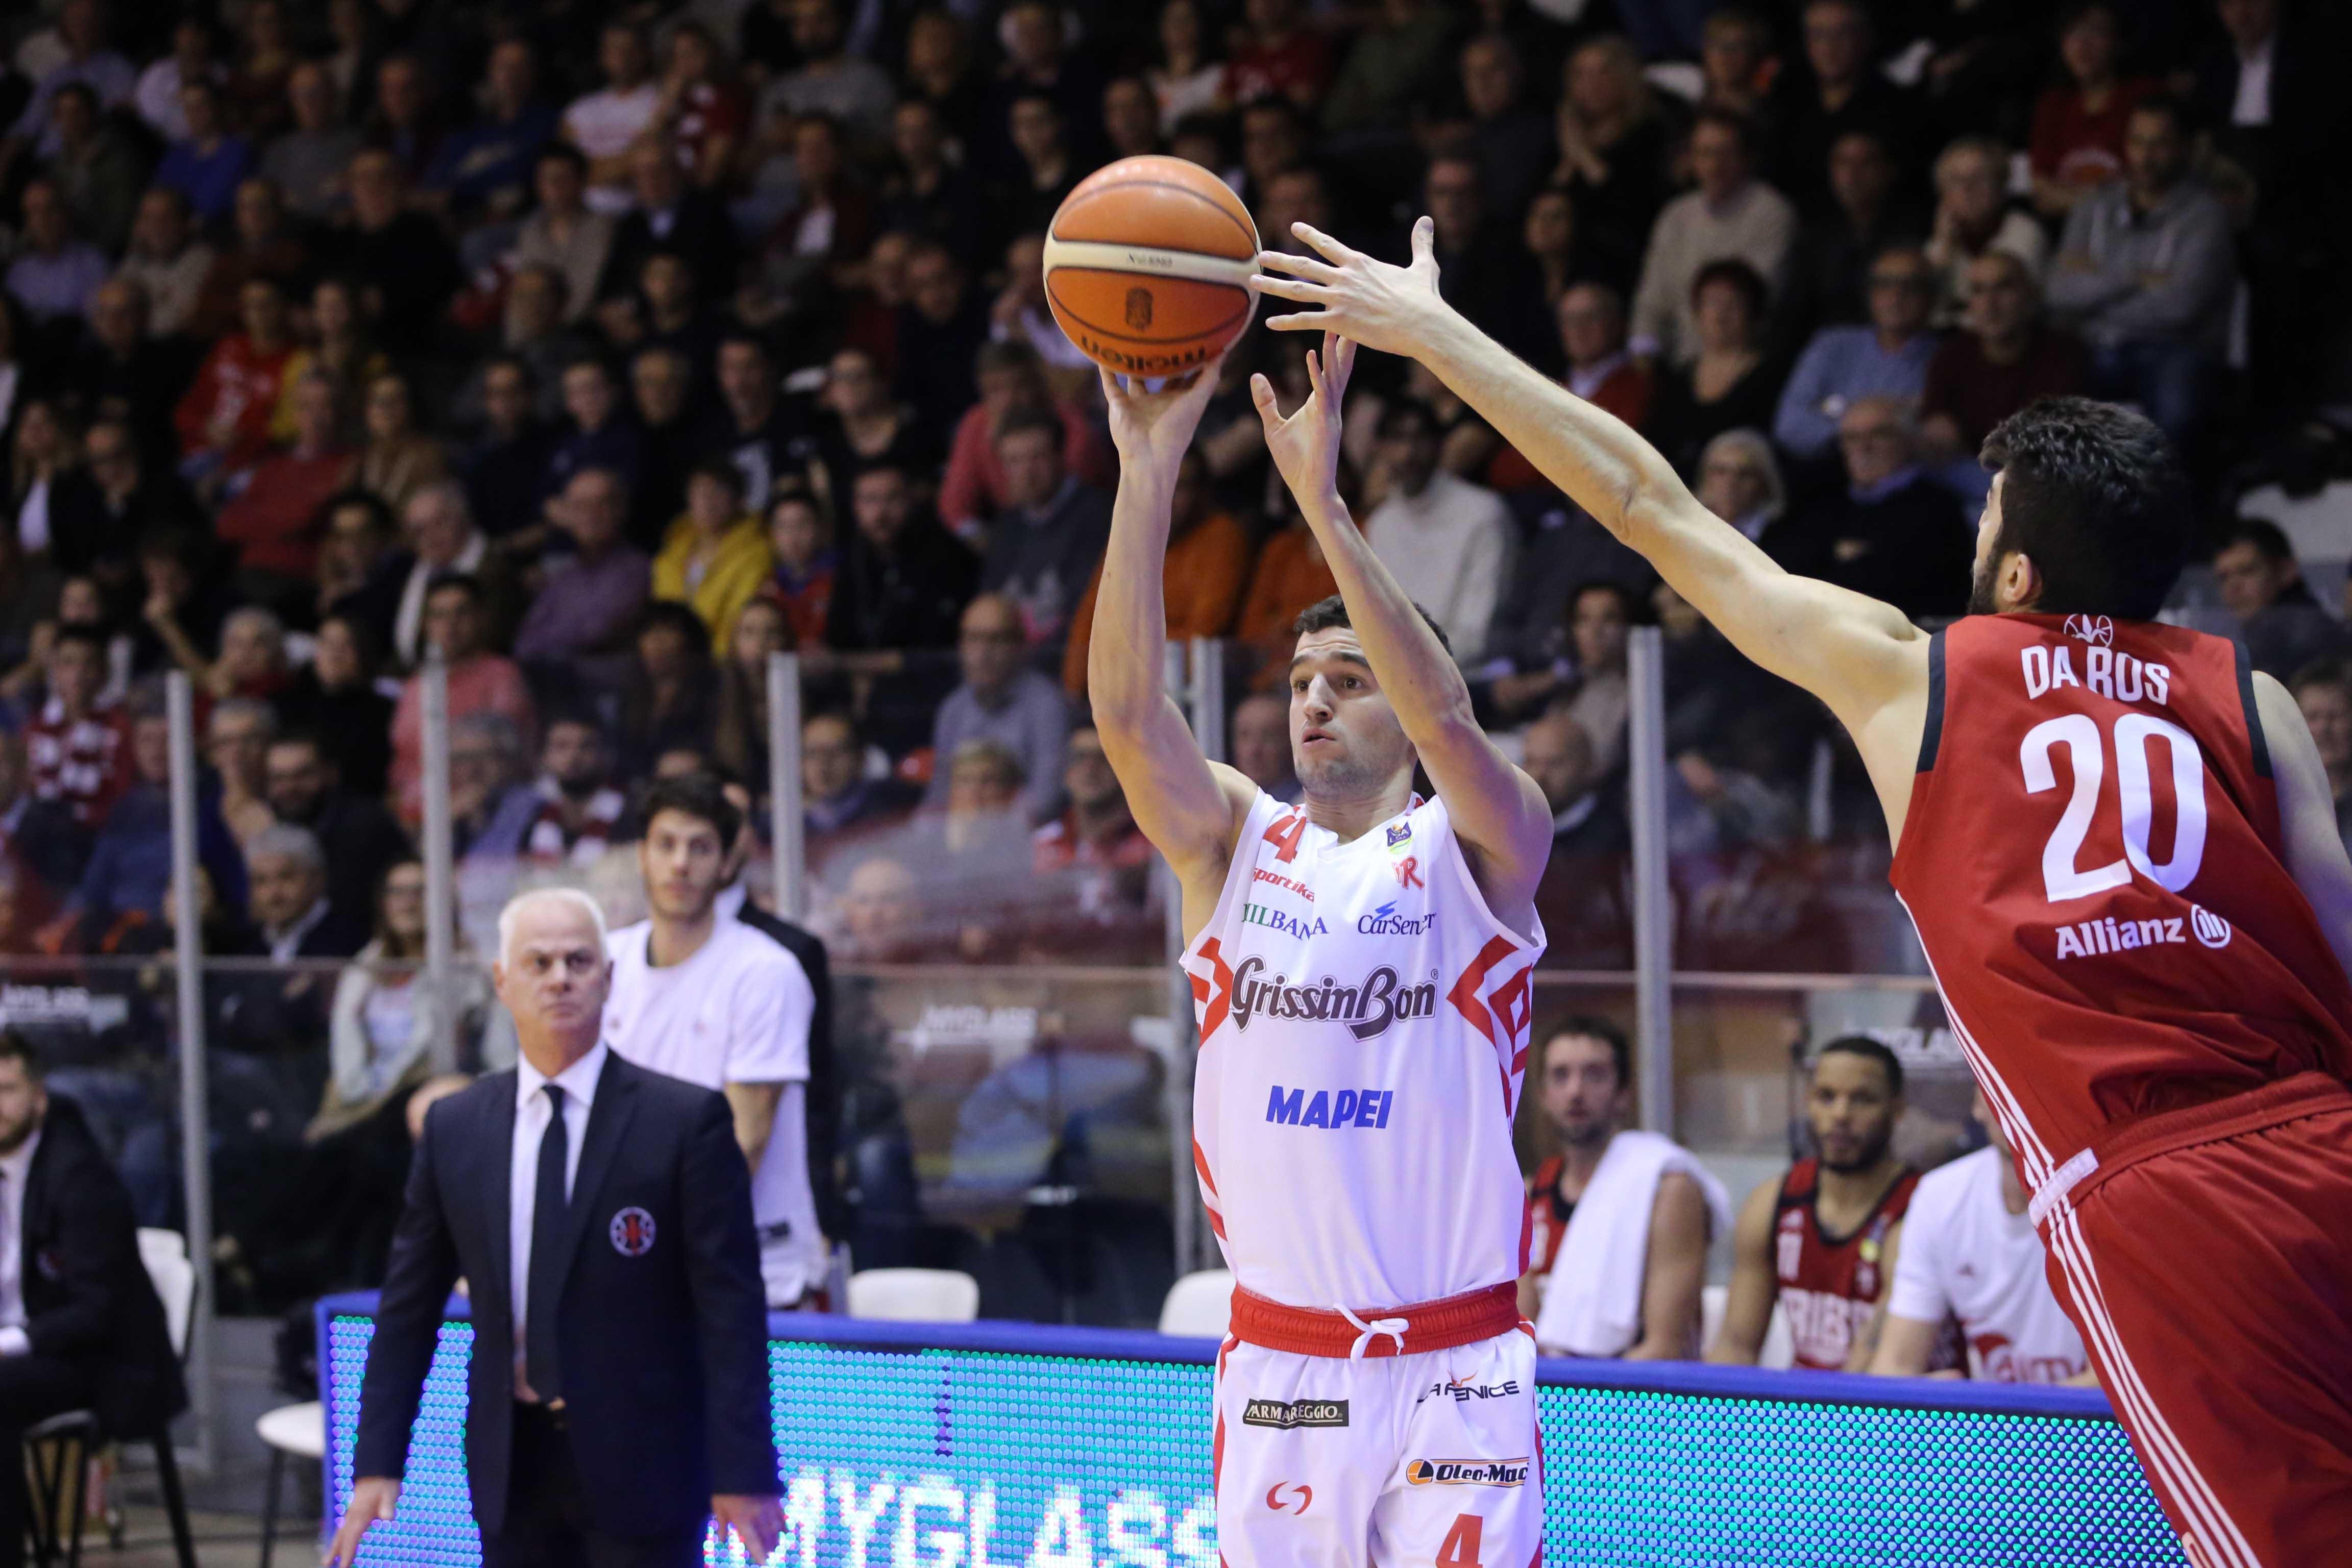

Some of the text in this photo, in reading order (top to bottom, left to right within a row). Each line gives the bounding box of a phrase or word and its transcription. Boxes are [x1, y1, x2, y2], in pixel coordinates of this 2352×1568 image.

[2021, 646, 2170, 705] DA ROS
[2020, 713, 2207, 902] 20
[1262, 815, 1307, 864] 4
[2055, 917, 2186, 960] Allianz
[1230, 954, 1438, 1043] GrissinBon
[1266, 1086, 1393, 1129] MAPEI
[1247, 1404, 1338, 1422] ARMAREGGIO
[1436, 1464, 1529, 1483] Oleo-Mac
[1435, 1513, 1483, 1568] 4
